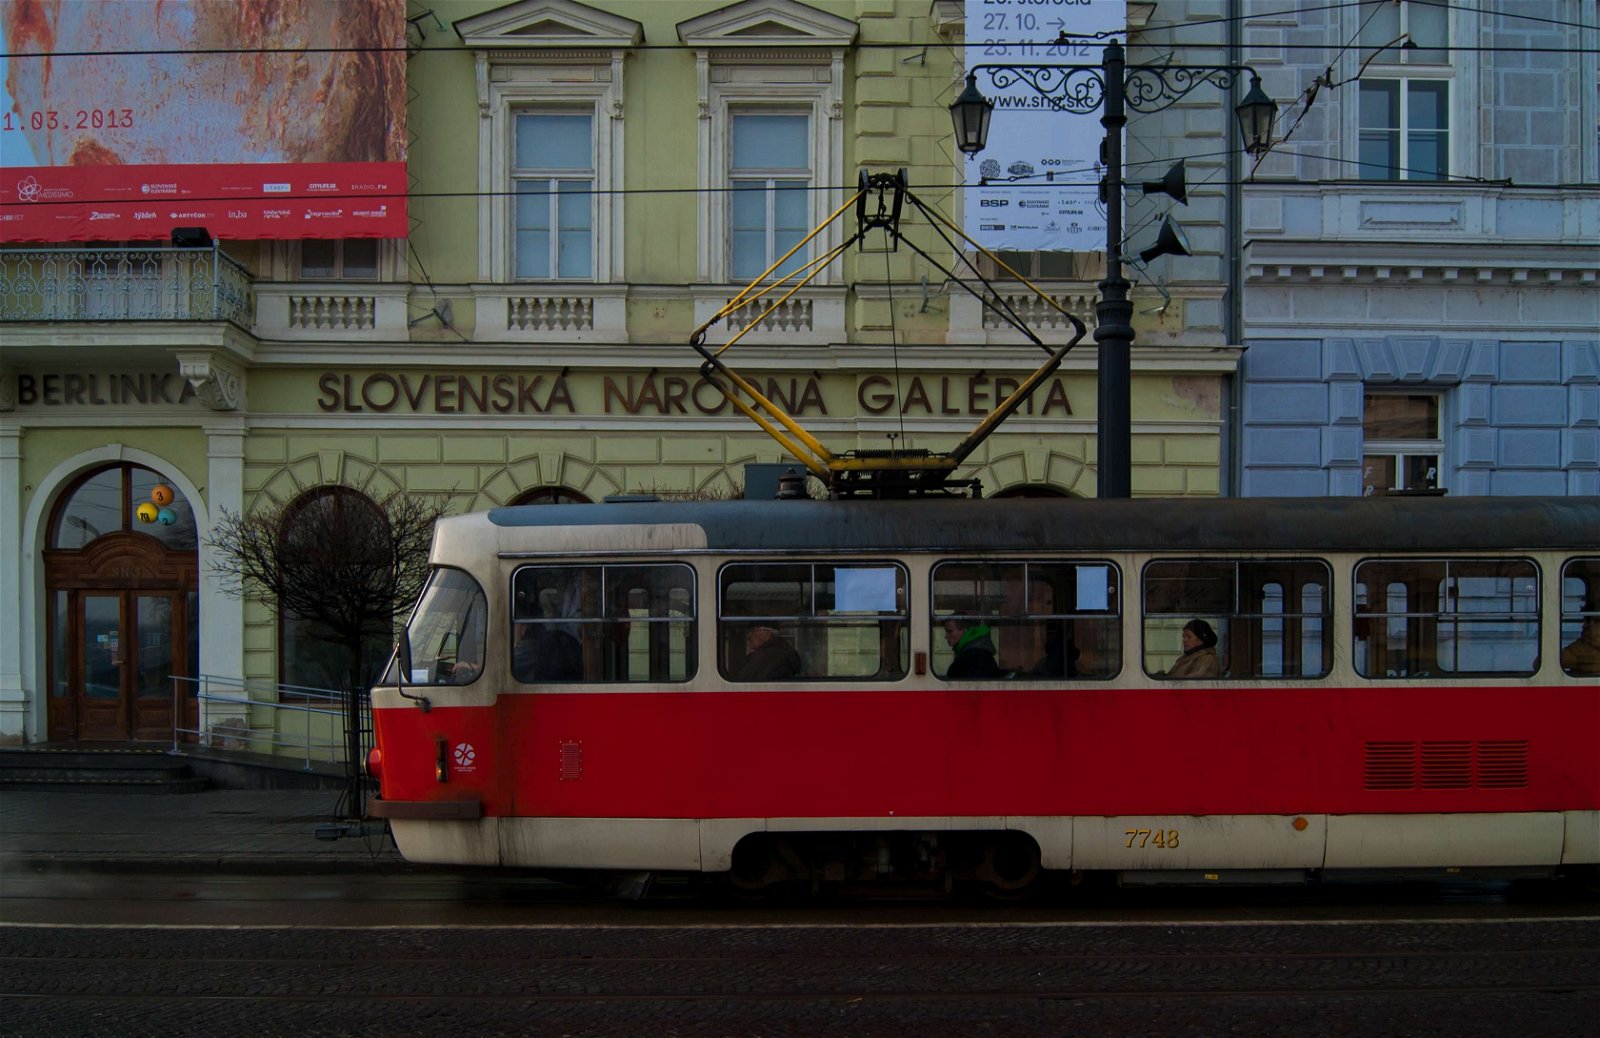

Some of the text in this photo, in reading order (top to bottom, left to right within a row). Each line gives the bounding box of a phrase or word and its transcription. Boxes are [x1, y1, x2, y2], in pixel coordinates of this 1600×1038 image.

[984, 13, 1040, 30] 27. 10.
[984, 39, 1090, 56] 25. 11. 2012
[980, 199, 1009, 207] BSP
[317, 366, 576, 413] SLOVENSKÁ
[858, 369, 1073, 416] GALÉRIA
[1426, 467, 1437, 480] R
[156, 491, 164, 501] 3
[111, 567, 142, 578] SNG
[1124, 829, 1180, 849] 7748
